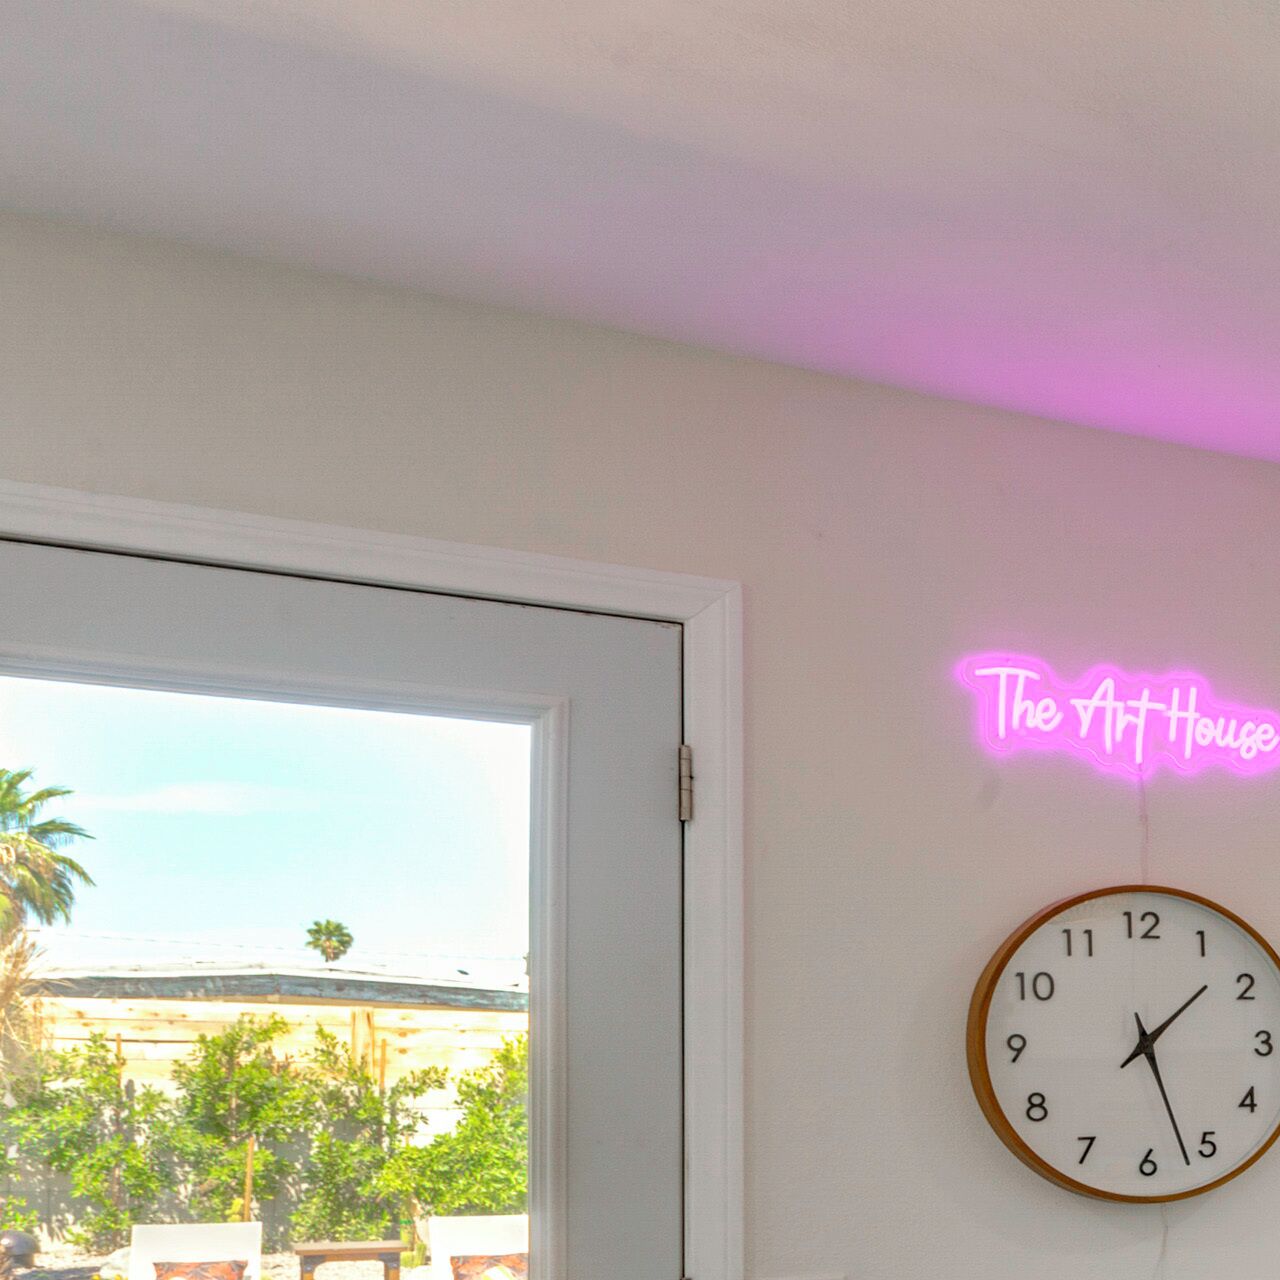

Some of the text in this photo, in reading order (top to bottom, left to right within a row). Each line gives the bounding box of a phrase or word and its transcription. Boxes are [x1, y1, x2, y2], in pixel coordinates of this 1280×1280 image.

[974, 666, 1280, 765] The Art House
[1122, 911, 1161, 940] 12
[1061, 928, 1093, 957] 11
[1195, 930, 1206, 958] 1
[1014, 971, 1055, 1001] 10
[1236, 973, 1256, 1001] 2
[1006, 1033, 1027, 1064] 9
[1253, 1030, 1274, 1057] 3
[1025, 1092, 1049, 1122] 8
[1237, 1085, 1258, 1113] 4
[1077, 1136, 1097, 1165] 7
[1197, 1131, 1217, 1158] 5
[1138, 1147, 1158, 1176] 6
